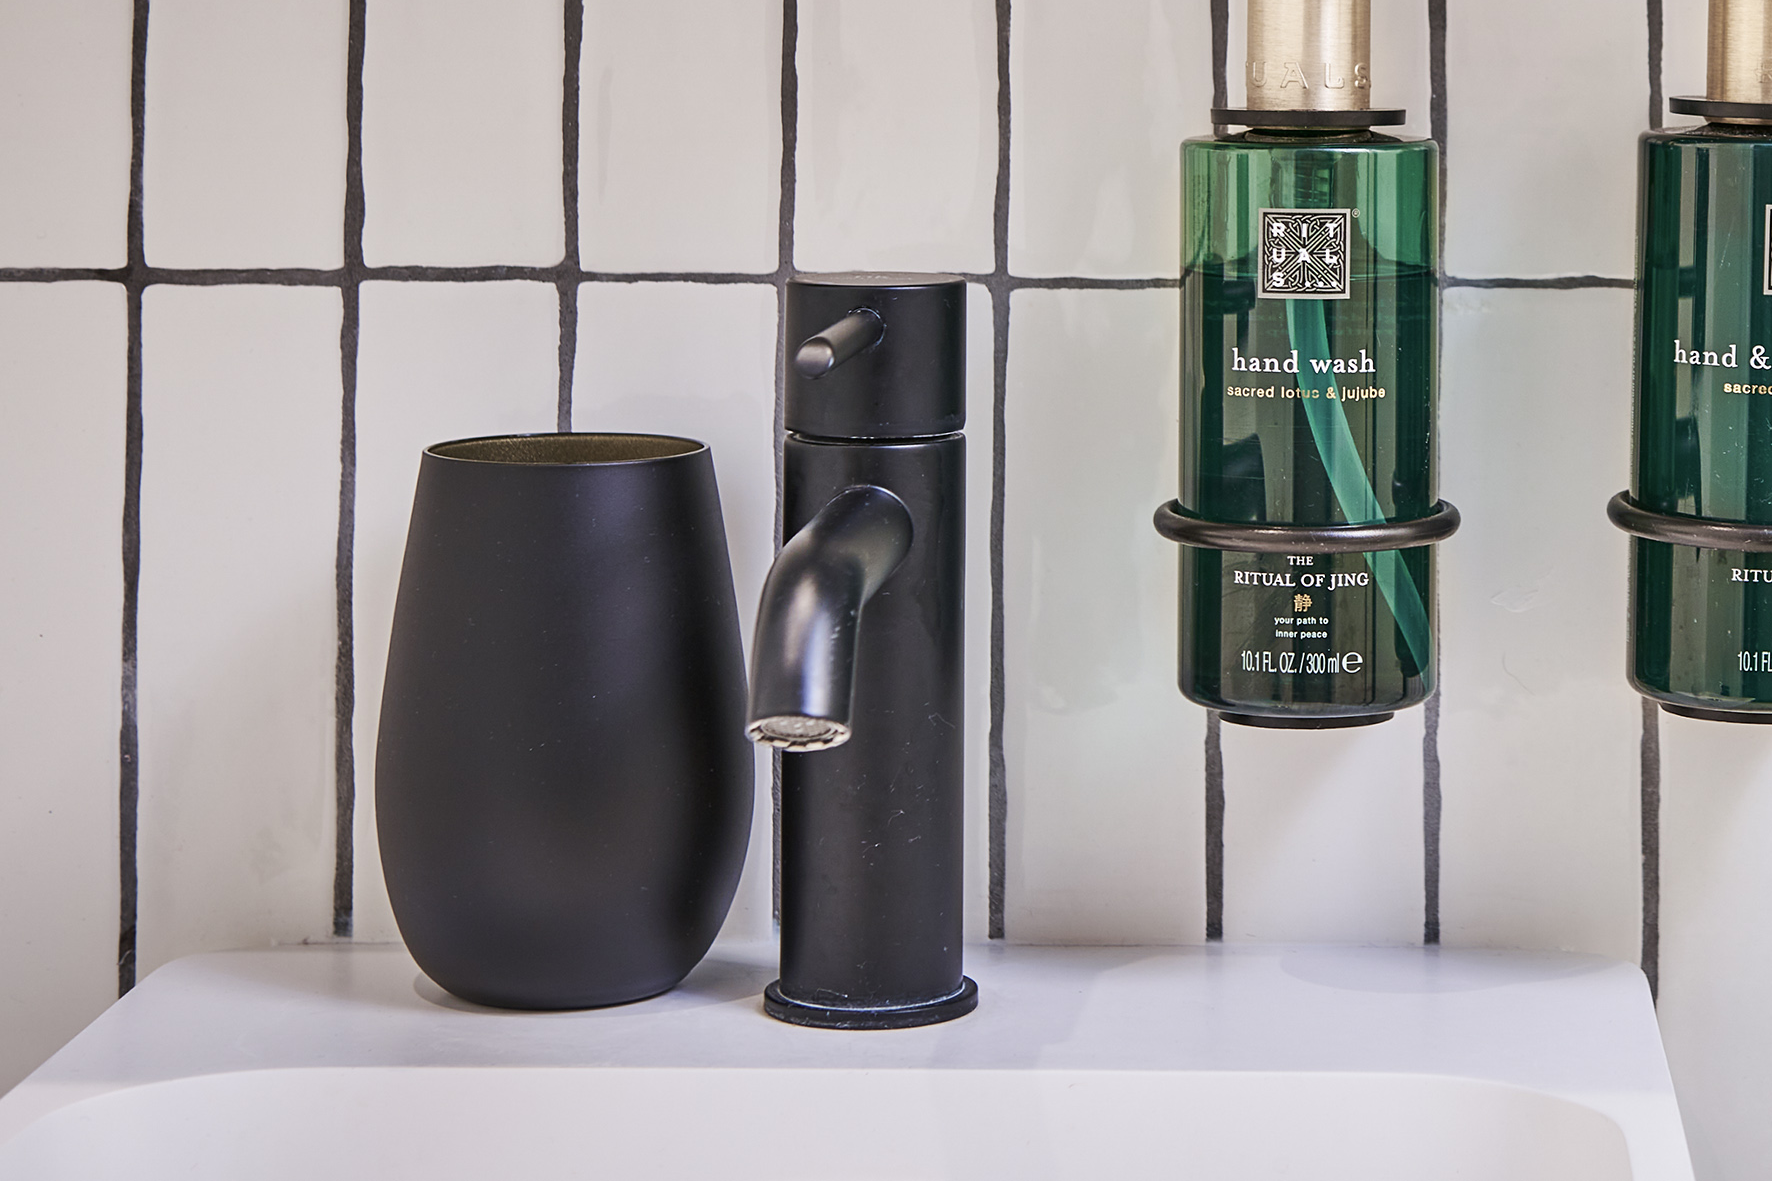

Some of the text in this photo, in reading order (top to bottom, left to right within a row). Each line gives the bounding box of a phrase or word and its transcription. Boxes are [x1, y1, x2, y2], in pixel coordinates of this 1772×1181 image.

[1231, 347, 1377, 374] hand wash
[1673, 339, 1739, 368] hand
[1749, 345, 1772, 370] &
[1226, 385, 1275, 398] sacred
[1325, 386, 1337, 399] &
[1340, 386, 1387, 402] jujube
[1286, 555, 1314, 566] THE
[1233, 570, 1370, 591] RITUAL OF JING
[1274, 616, 1329, 626] your path to
[1275, 629, 1328, 639] inner peace
[1241, 650, 1260, 672] 10.1
[1262, 651, 1277, 673] FL.
[1279, 651, 1297, 674] OZ.
[1737, 650, 1758, 672] 10.1
